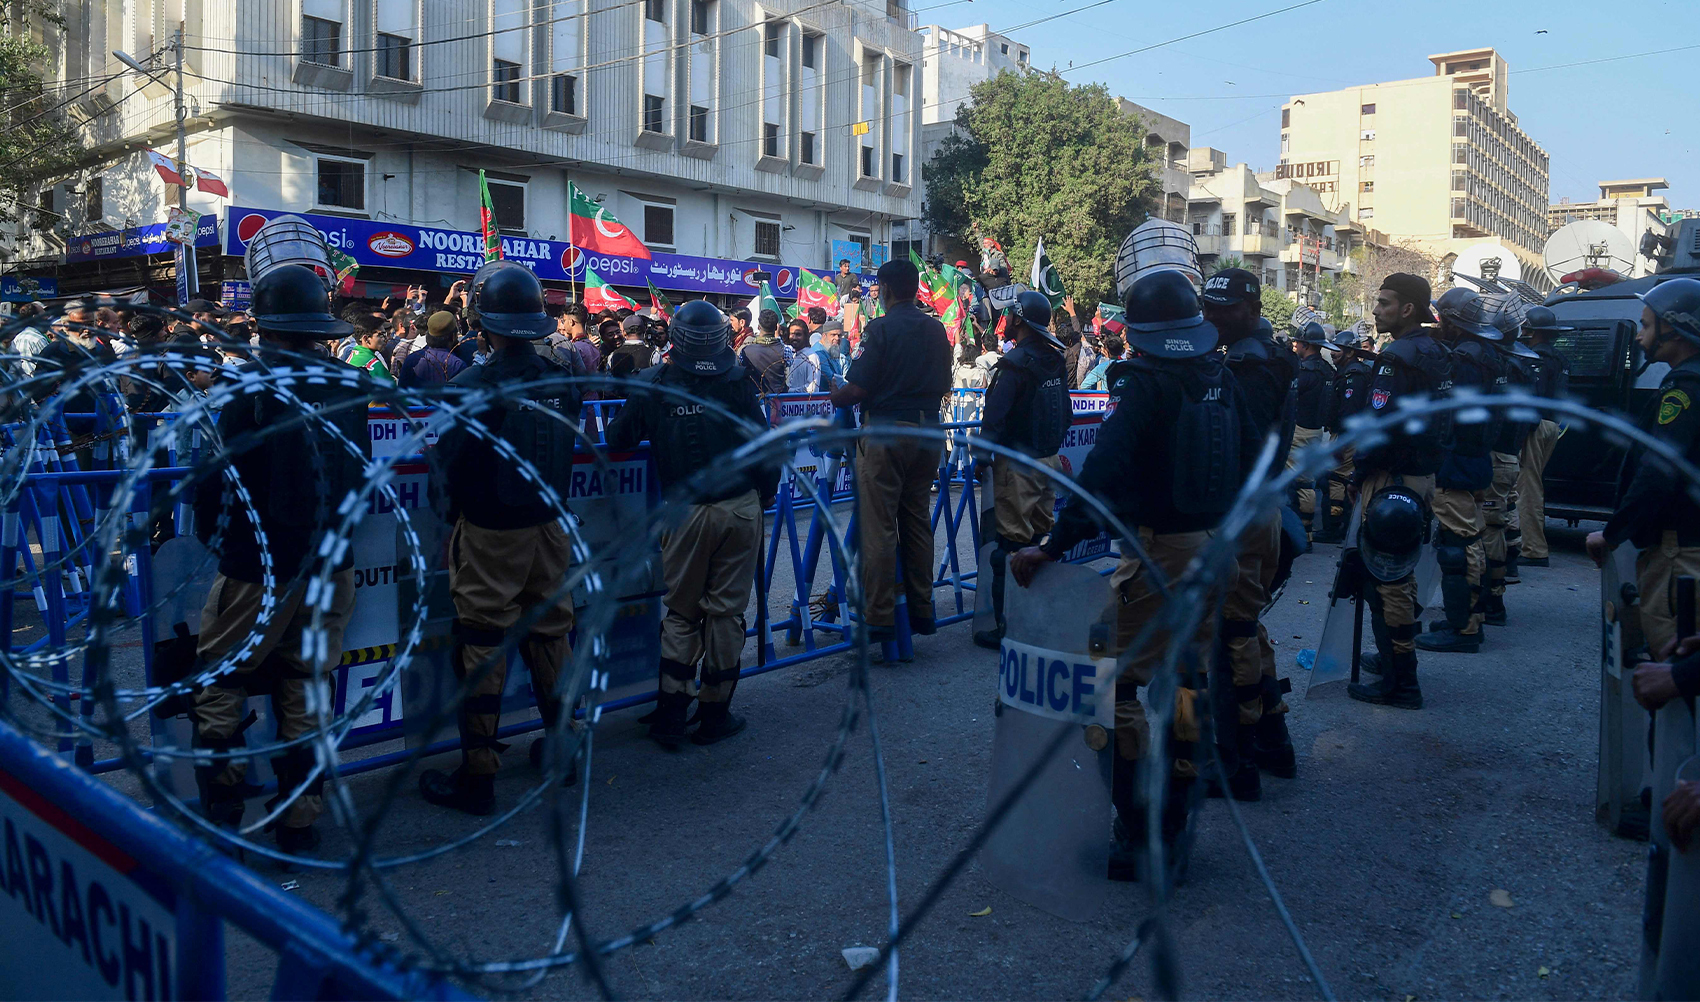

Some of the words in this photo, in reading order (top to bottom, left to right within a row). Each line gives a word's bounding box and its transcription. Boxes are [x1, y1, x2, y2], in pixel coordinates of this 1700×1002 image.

[418, 230, 551, 260] NOOREAHAR
[1164, 343, 1195, 352] POLICE
[1165, 338, 1190, 346] SINDH
[781, 404, 804, 417] SINDH
[806, 403, 831, 416] POLICE
[999, 644, 1097, 717] POLICE
[0, 816, 171, 1002] ARACHI
